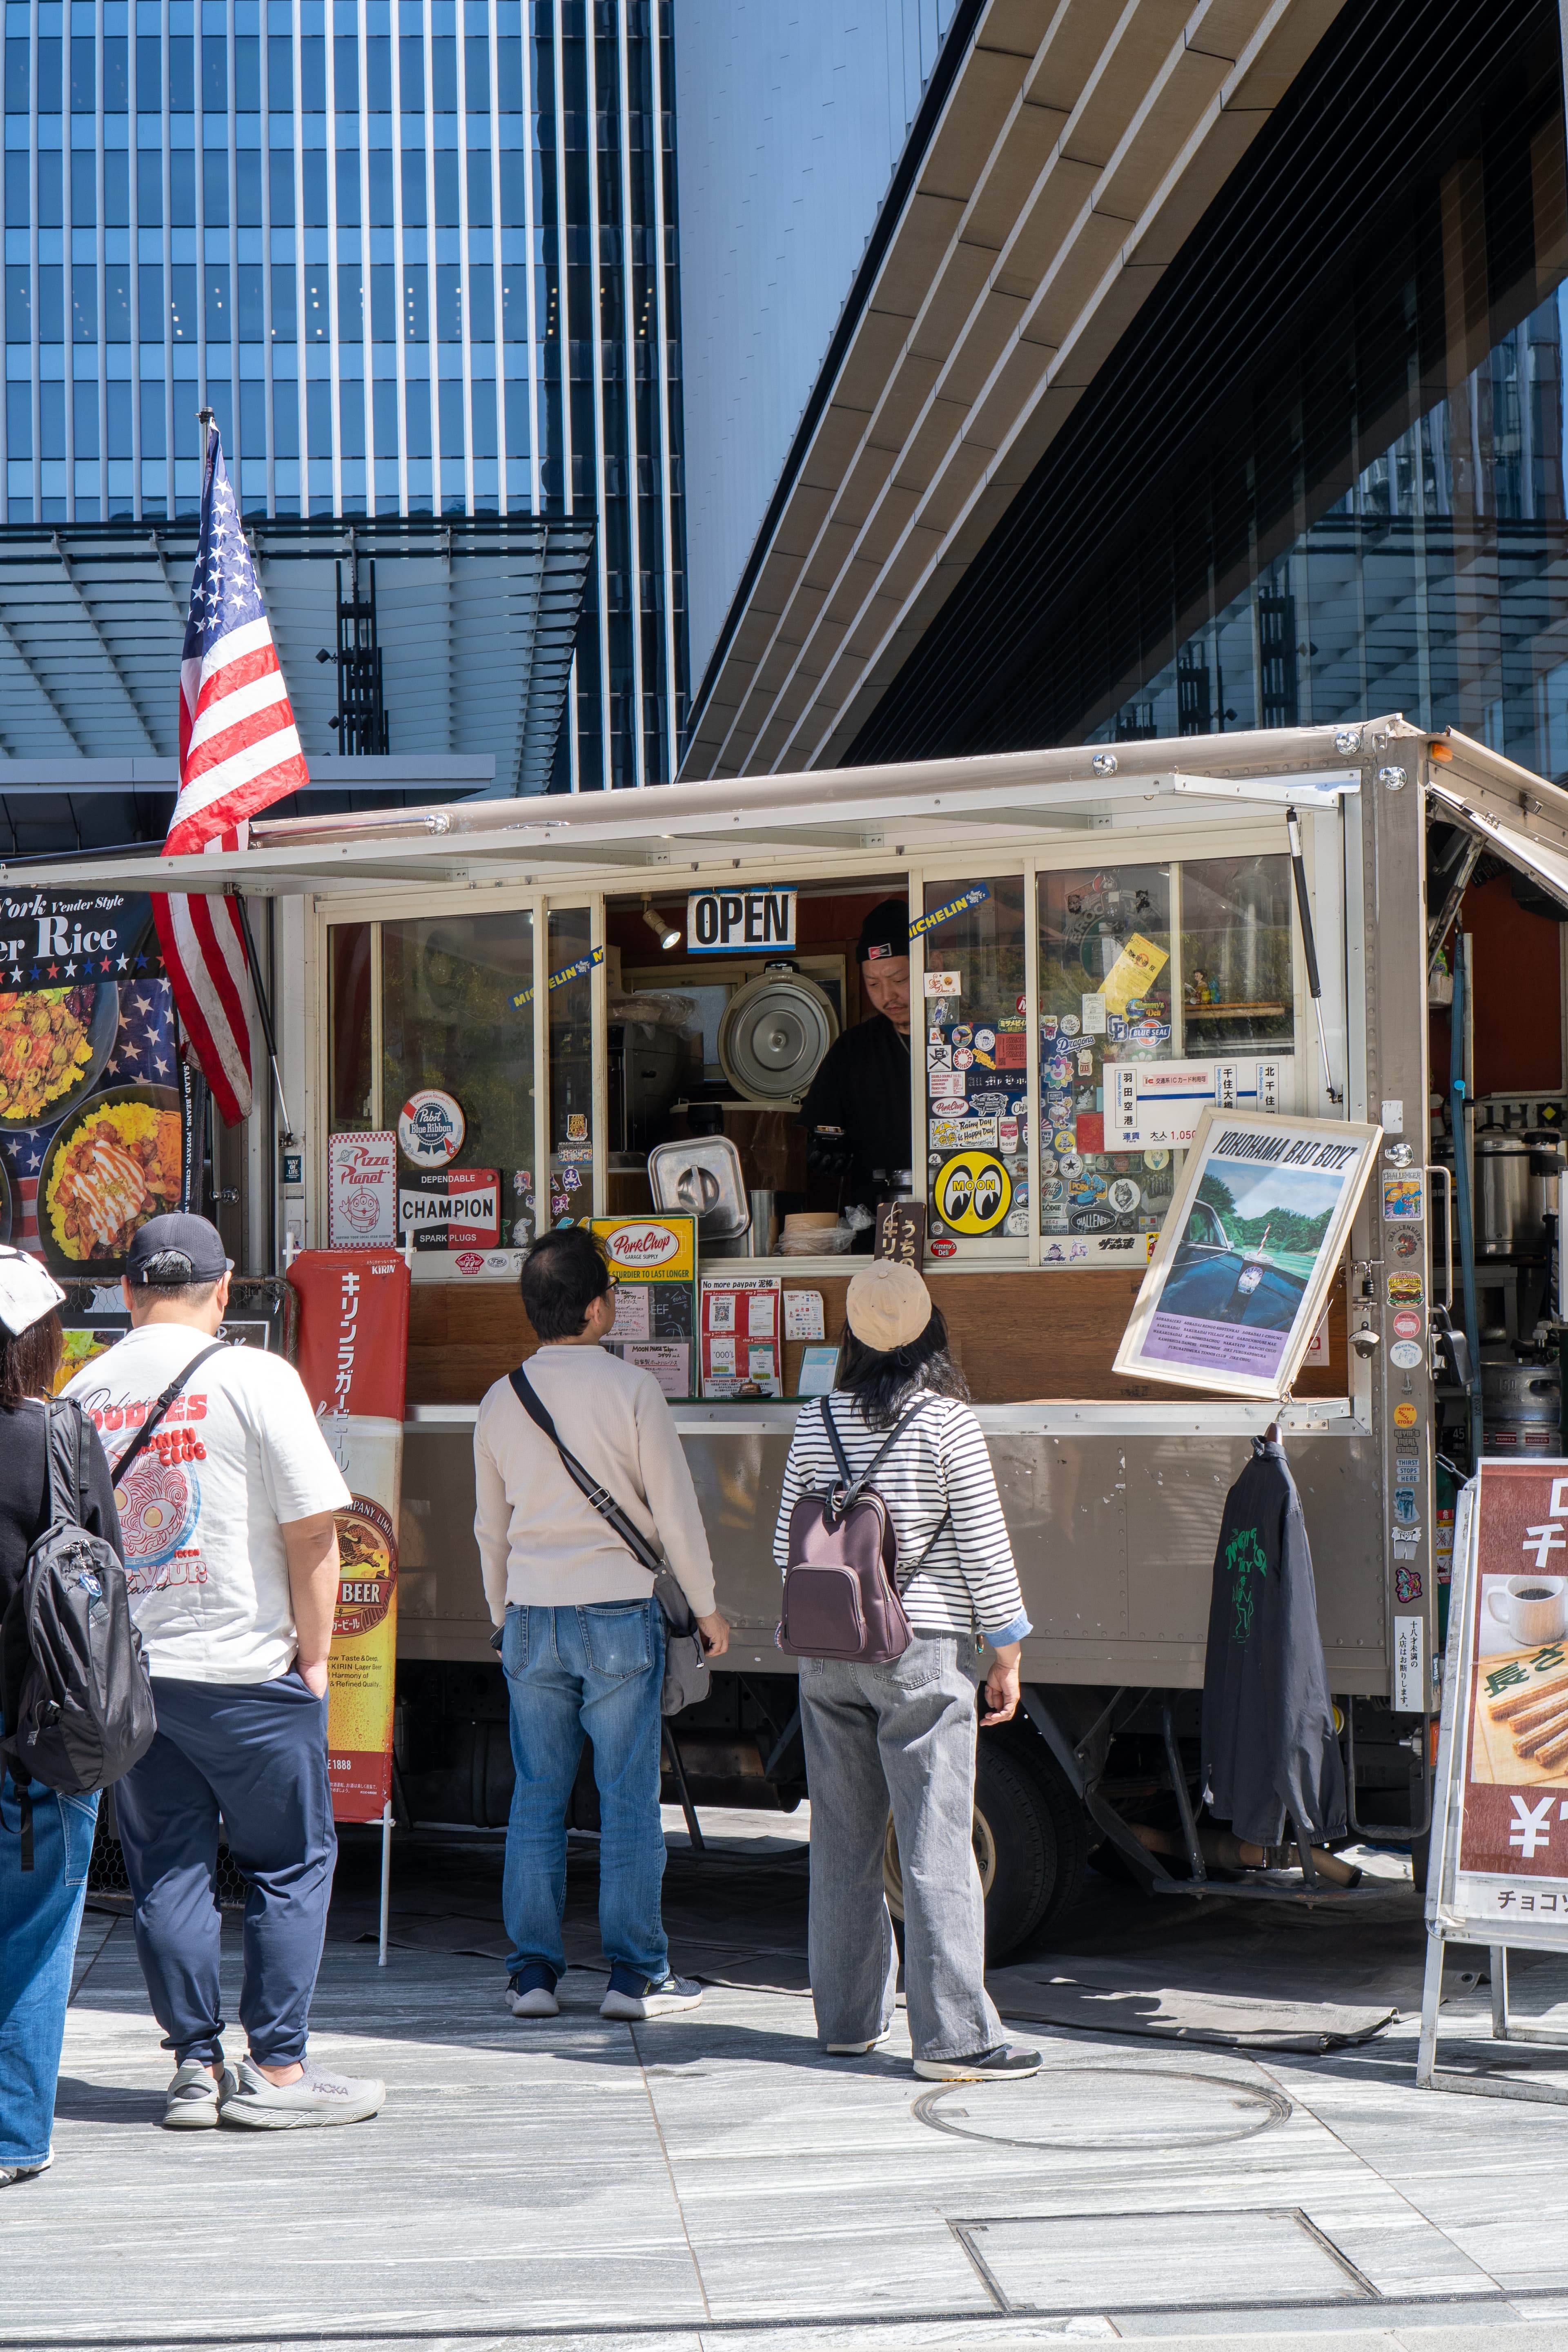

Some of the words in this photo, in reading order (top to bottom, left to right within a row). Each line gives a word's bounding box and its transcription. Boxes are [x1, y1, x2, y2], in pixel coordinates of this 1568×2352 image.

[52, 899, 93, 913] Vender
[94, 895, 124, 910] Style
[695, 895, 789, 944] OPEN
[33, 916, 117, 958] Rice
[1058, 1037, 1095, 1051] Dragons
[1156, 1076, 1206, 1085] 交通系ICカード利用可
[1224, 1069, 1233, 1108] 千住大橋
[1124, 1074, 1133, 1125] 羽田空港
[419, 1109, 442, 1122] Pabst
[411, 1124, 426, 1134] Blue
[427, 1123, 452, 1133] Ribbon
[960, 1121, 978, 1130] Rainy
[979, 1119, 991, 1127] Day
[962, 1131, 982, 1140] Happy
[983, 1126, 995, 1135] Day!
[349, 1146, 390, 1166] Pizza
[1212, 1131, 1290, 1161] YOKOHAMA
[1282, 1140, 1321, 1165] BAD
[1312, 1144, 1358, 1169] BOYZ
[336, 1164, 390, 1185] Planet
[421, 1174, 475, 1183] DEPENDABLE
[953, 1180, 995, 1191] MOON
[402, 1198, 493, 1219] CHAMPION
[1077, 1214, 1110, 1227] CHALLENGER
[450, 1234, 477, 1242] PLUGS
[613, 1234, 643, 1255] Pork
[644, 1232, 670, 1252] Chop
[372, 1265, 395, 1274] KIRIN
[758, 1279, 773, 1287] 泥棒
[1153, 1329, 1183, 1337] WAKAKUSADAI
[1185, 1334, 1220, 1344] KAMOSHIDACHOU
[1168, 1345, 1200, 1354] FURUSATOMURA
[1233, 1349, 1266, 1358] FURUSATOMURA
[1398, 1411, 1409, 1421] MEAL
[1394, 1429, 1420, 1439] HEYM'S
[1453, 1429, 1464, 1439] 45
[1398, 1438, 1417, 1447] MEAL
[160, 1442, 207, 1467] CLUB
[1396, 1446, 1419, 1455] STORE
[342, 1583, 380, 1603] BEER
[1399, 1632, 1408, 1707] 入店はお断りします。
[1484, 1642, 1566, 1699] 長さ
[333, 1760, 351, 1770] 1888
[312, 2083, 349, 2096] HOKA
